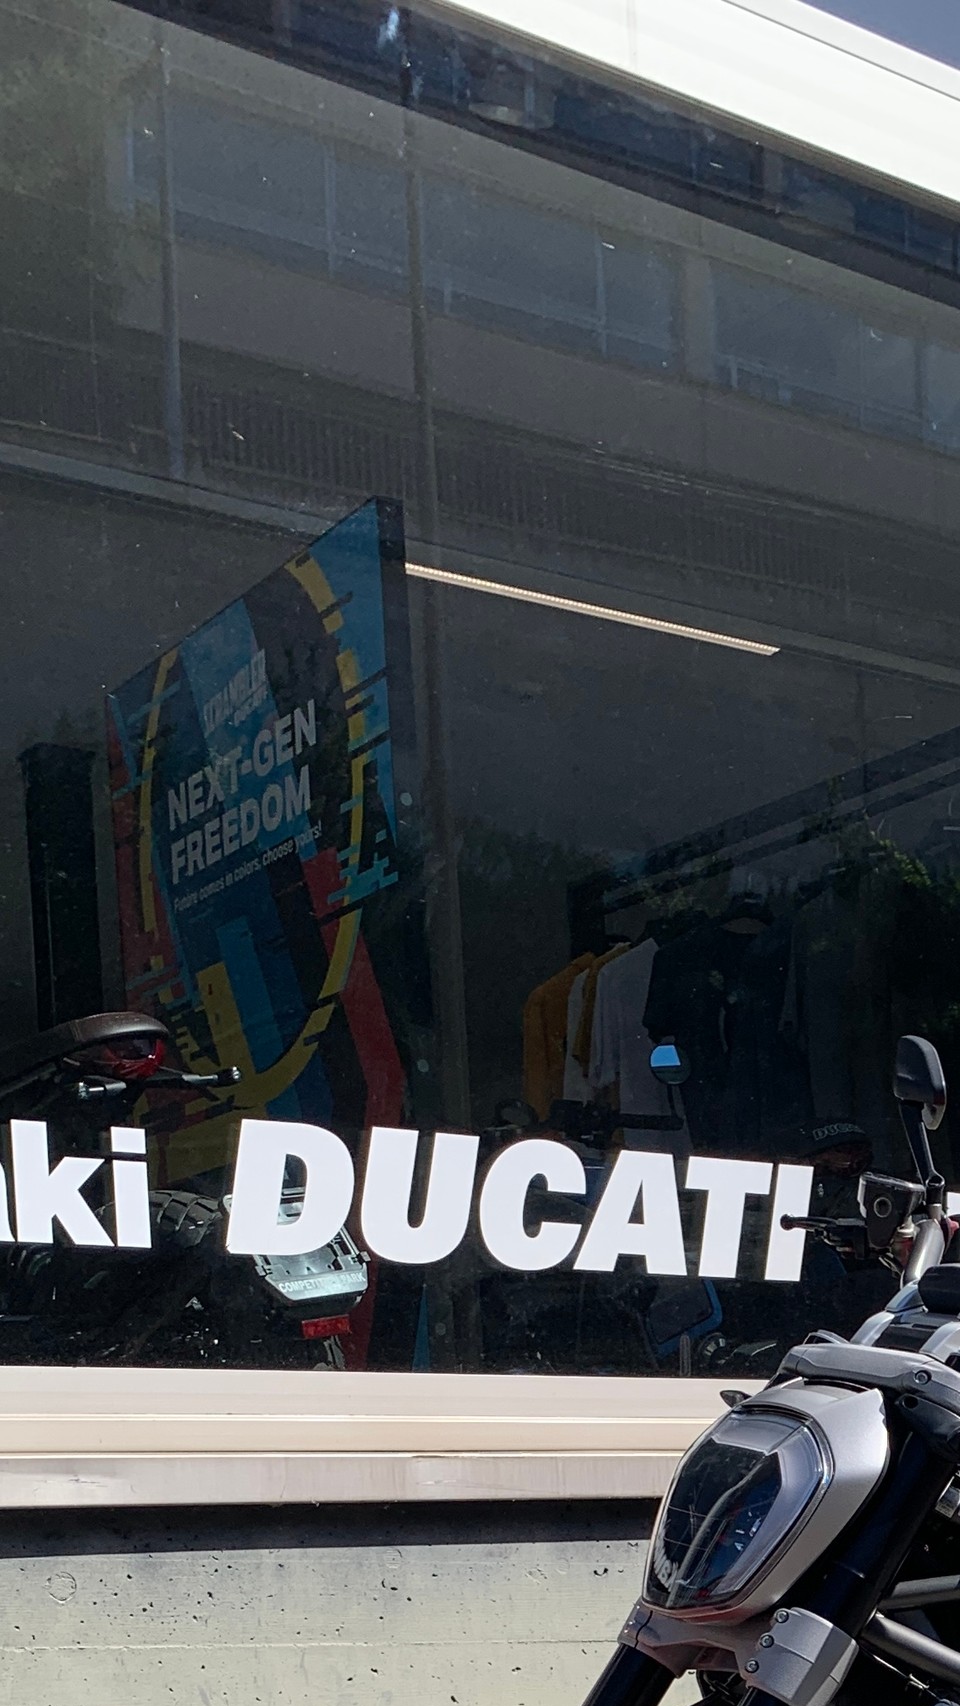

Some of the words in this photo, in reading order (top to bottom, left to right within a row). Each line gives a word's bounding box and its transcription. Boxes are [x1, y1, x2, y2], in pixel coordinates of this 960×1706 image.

[168, 698, 317, 831] NEXT-GEN
[170, 764, 312, 885] FREEDOM
[199, 878, 225, 900] comes
[262, 838, 294, 866] choose
[0, 1119, 152, 1249] ki
[225, 1118, 814, 1282] DUCATI
[340, 1272, 366, 1287] PARK
